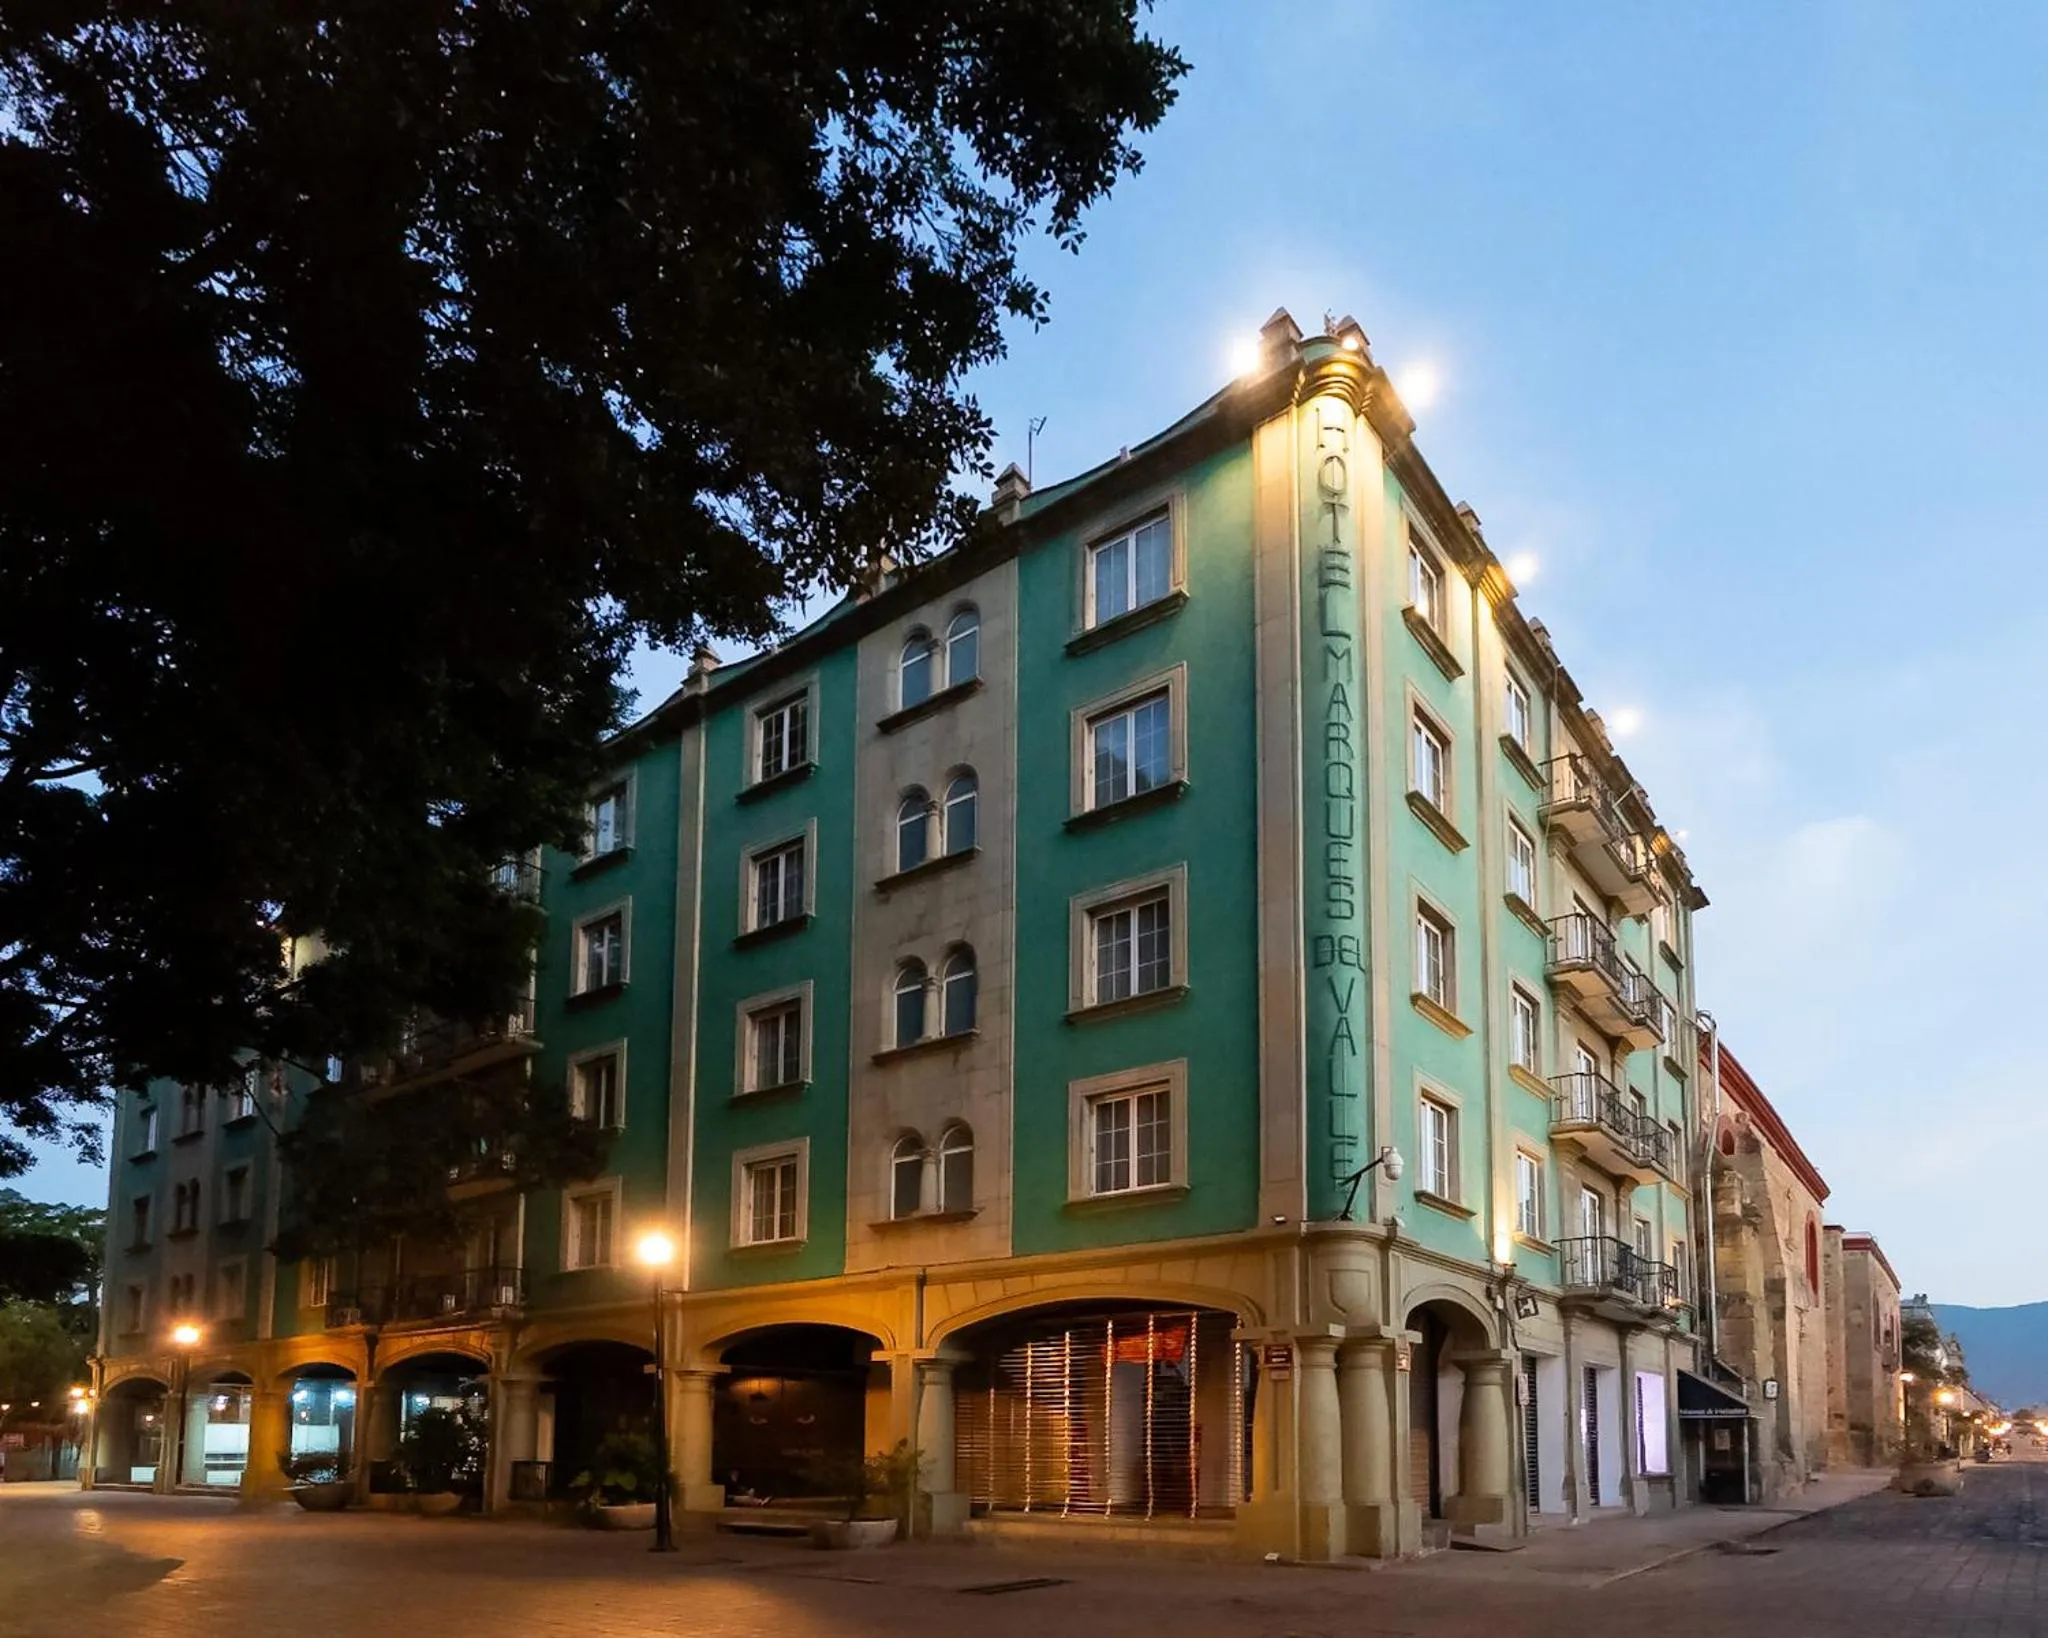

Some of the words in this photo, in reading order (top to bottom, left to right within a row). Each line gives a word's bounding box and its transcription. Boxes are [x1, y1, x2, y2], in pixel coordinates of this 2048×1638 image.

[1324, 645, 1356, 920] MARQUES
[1313, 934, 1366, 975] DEL
[1327, 976, 1358, 1182] VALLE
